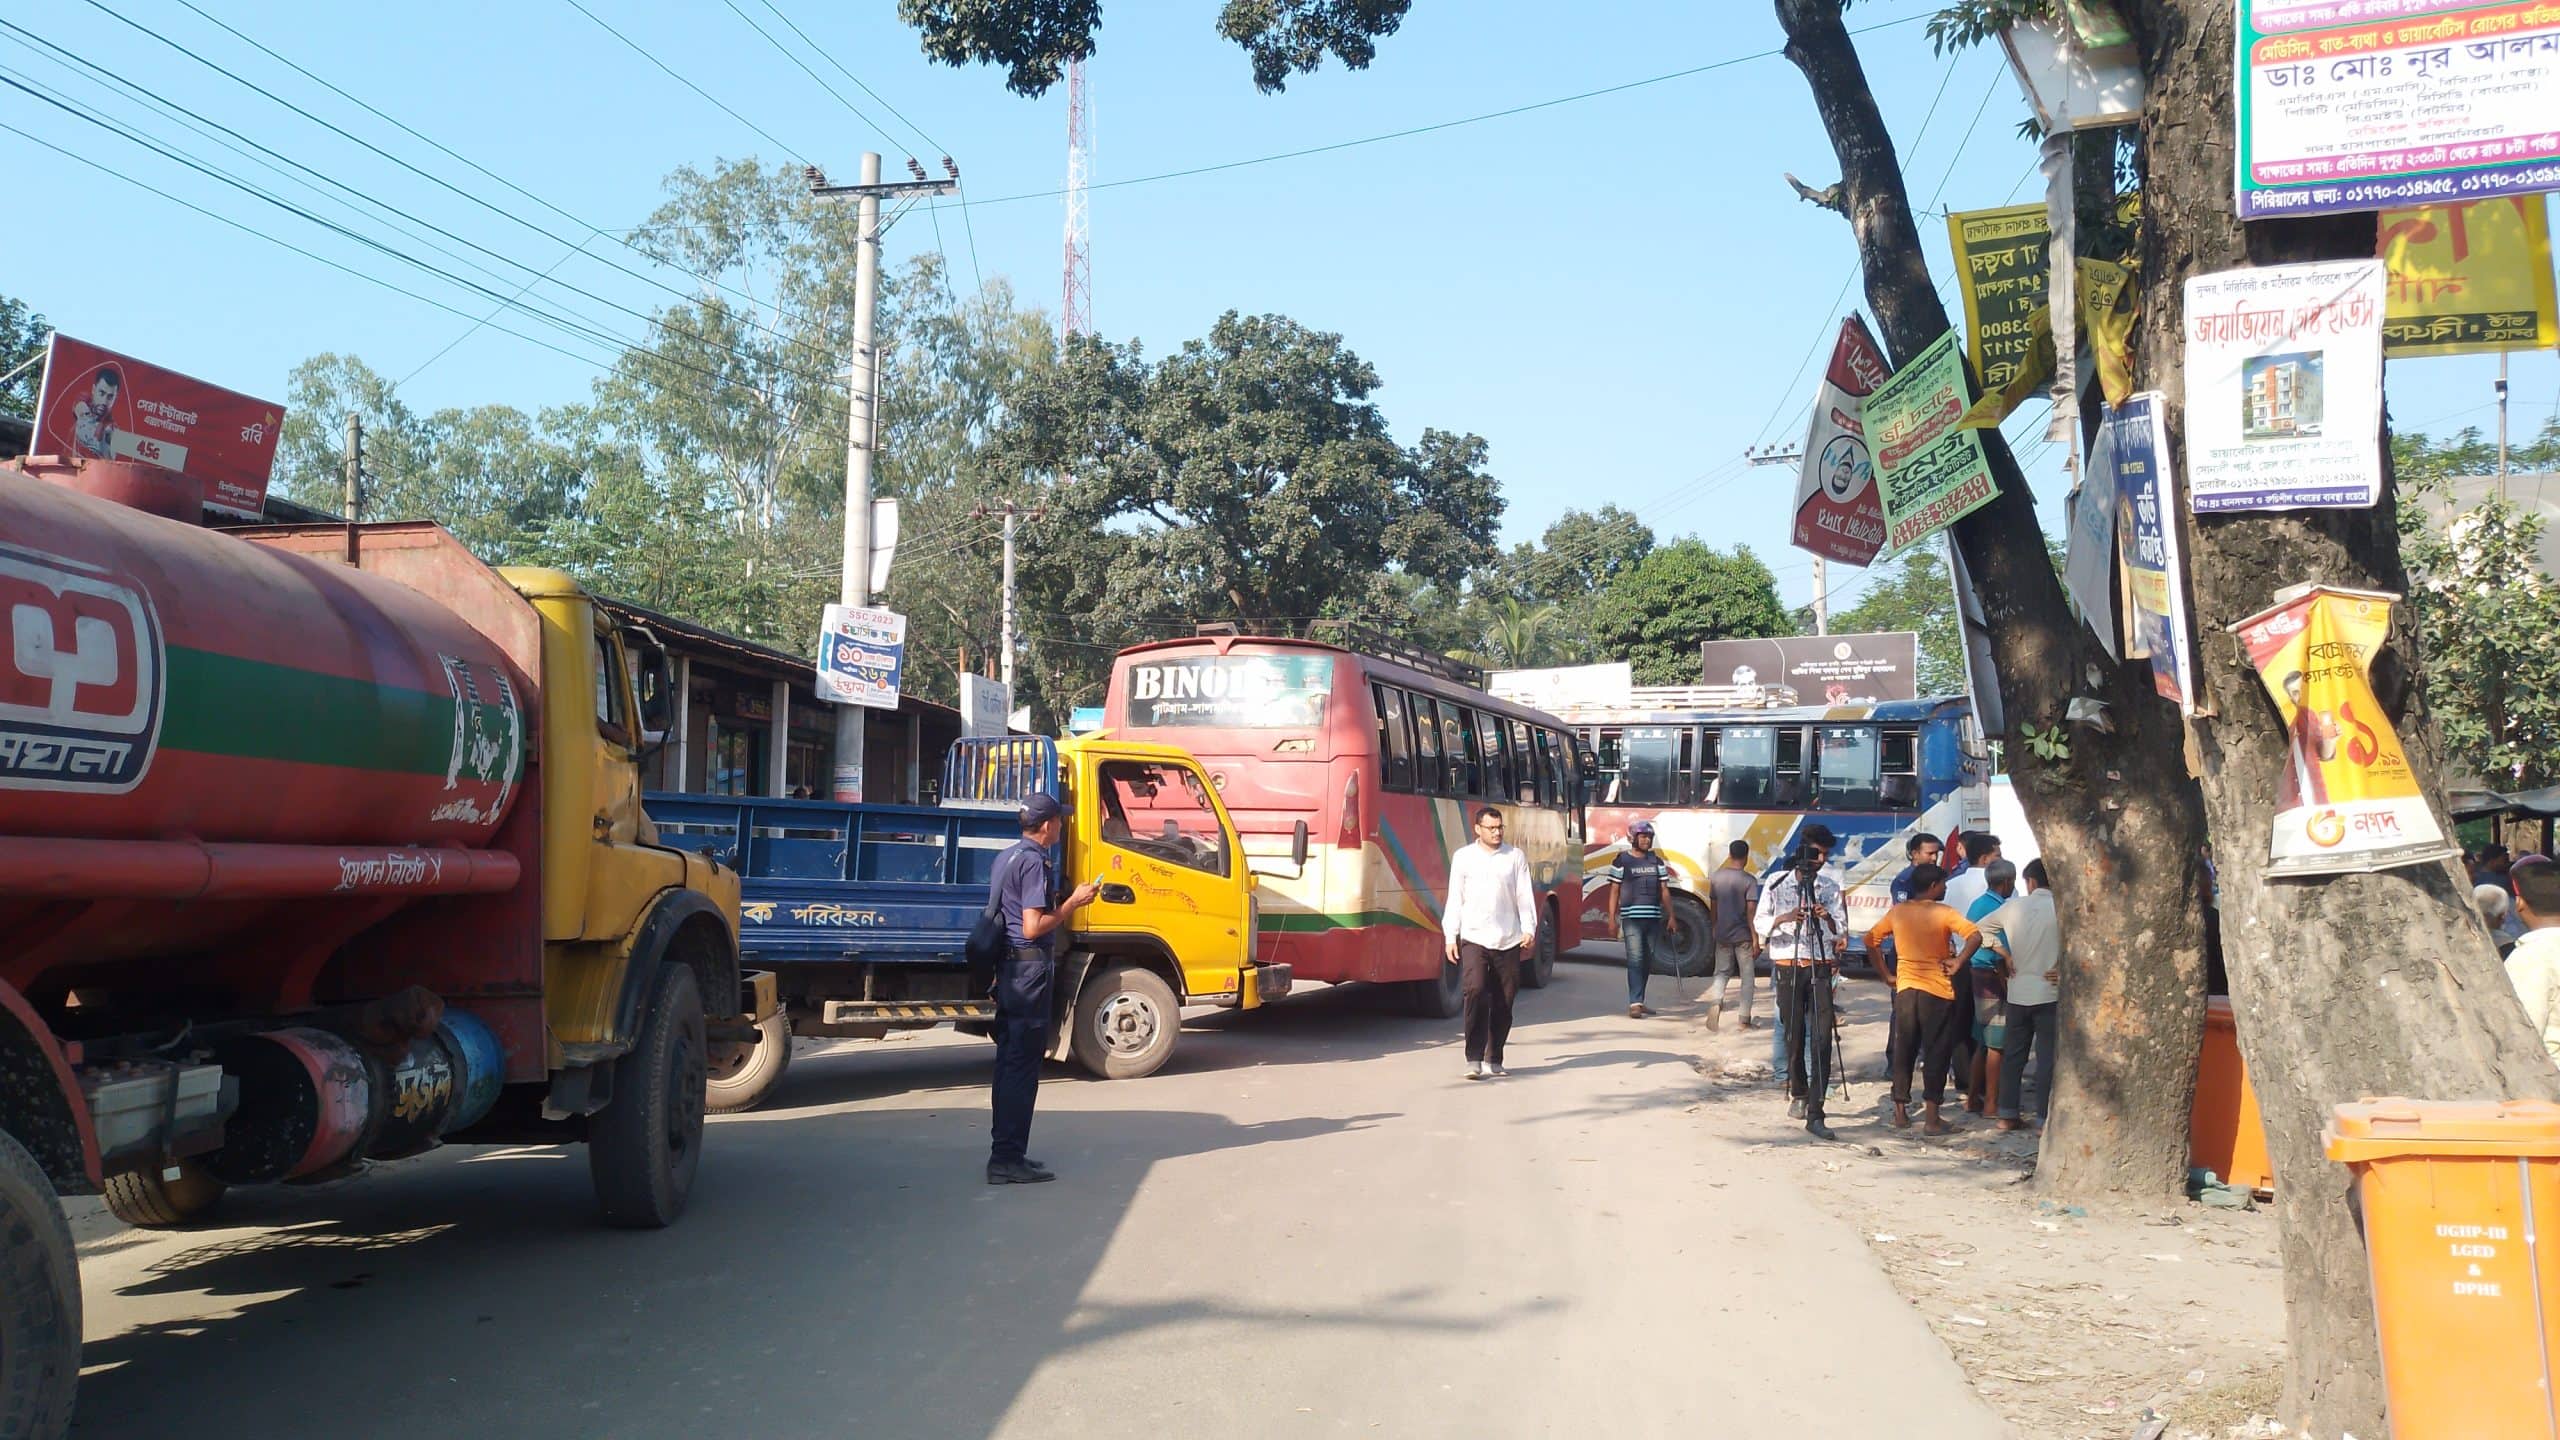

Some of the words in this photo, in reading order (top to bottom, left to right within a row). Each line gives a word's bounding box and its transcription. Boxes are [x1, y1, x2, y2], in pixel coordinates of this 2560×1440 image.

[2259, 37, 2315, 60] মেডিসিন,
[2319, 32, 2377, 53] বাত-ব্যথা
[2383, 31, 2394, 45] ও
[2398, 16, 2466, 45] ডায়াবেটিস
[2470, 14, 2516, 35] রোগের
[2263, 63, 2315, 87] ডাঃ
[2330, 54, 2393, 82] মোঃ
[2404, 47, 2453, 78] নূর
[2464, 32, 2560, 63] আলম
[240, 423, 264, 445] রবি
[848, 610, 869, 621] SSC
[839, 644, 863, 664] ১০
[2353, 809, 2402, 833] নগদ
[1111, 854, 1123, 871] R
[1631, 866, 1656, 875] POLICE
[1224, 976, 1236, 990] A
[2450, 1243, 2496, 1258] LGED
[2467, 1263, 2482, 1277] &
[2452, 1280, 2502, 1297] DPHE
